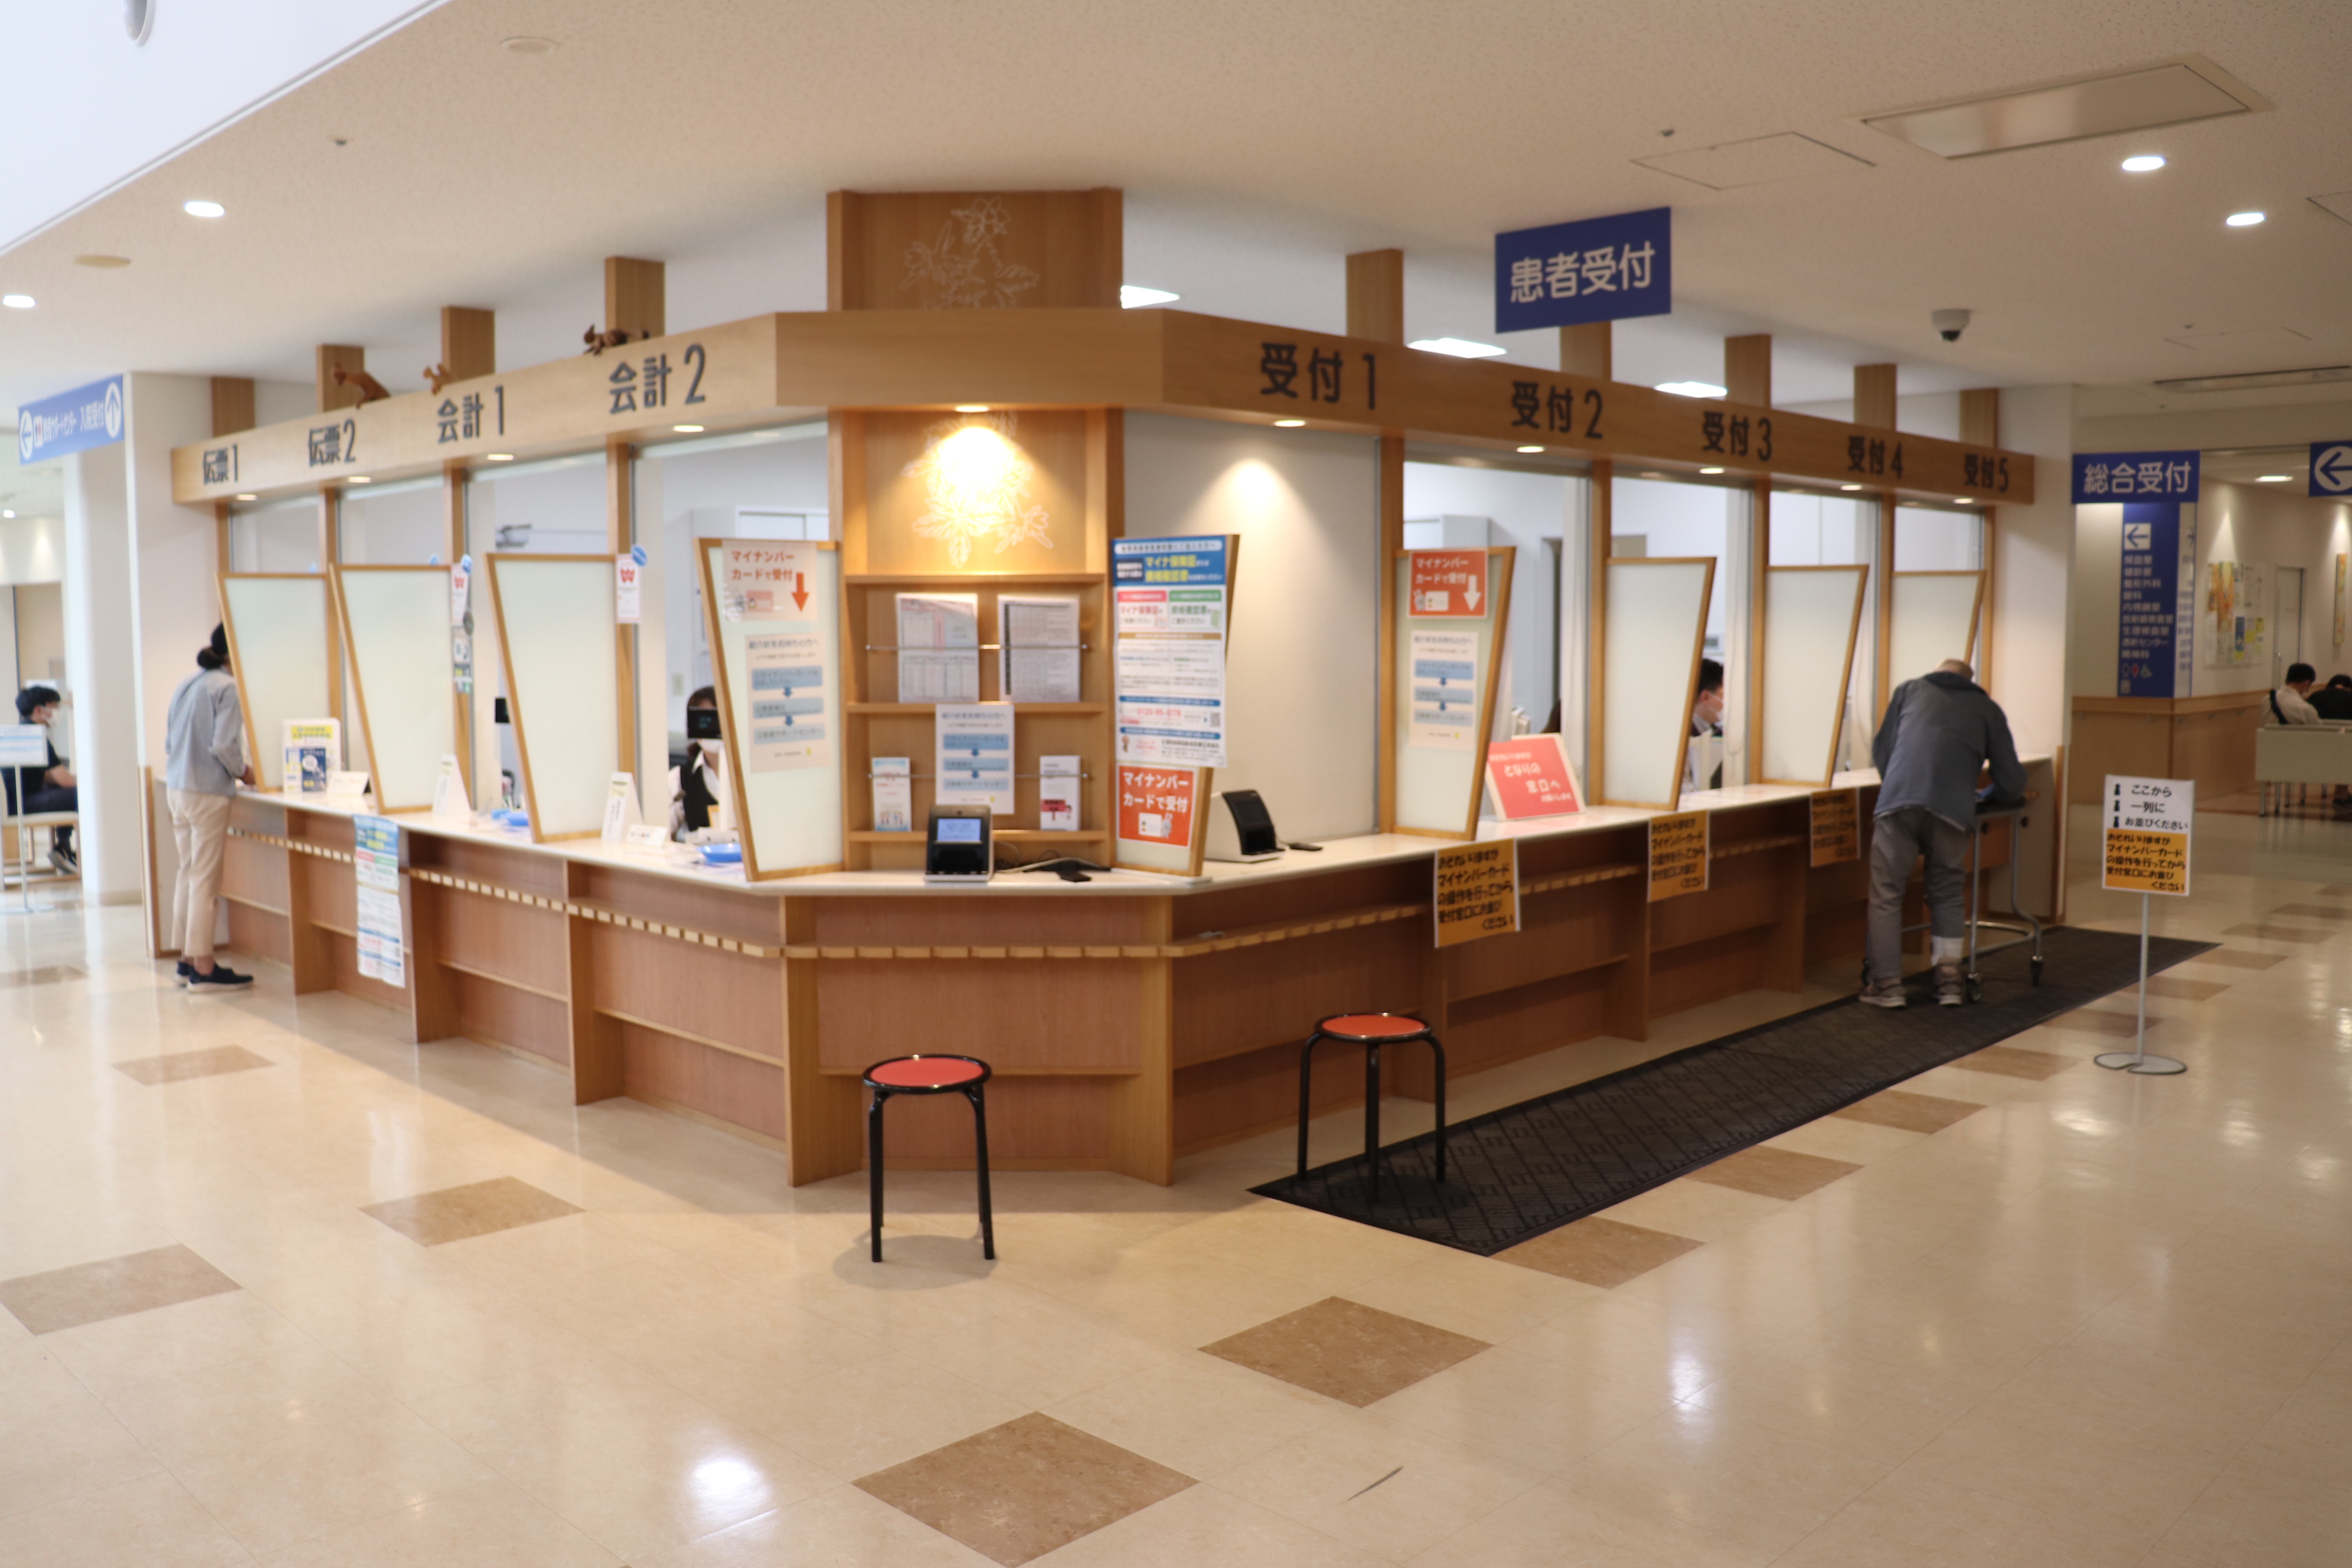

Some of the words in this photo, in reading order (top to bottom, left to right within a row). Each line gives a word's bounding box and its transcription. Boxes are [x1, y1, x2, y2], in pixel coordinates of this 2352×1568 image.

[1510, 241, 1655, 304] 患者受付
[2084, 461, 2191, 494] 総合受付
[731, 550, 796, 563] マイナンバー
[1123, 772, 1189, 789] マイナンバー
[2131, 785, 2172, 797] ここから
[1123, 792, 1188, 813] カードで受付
[2131, 801, 2165, 813] 一列に
[2125, 816, 2188, 830] お並びください
[2107, 844, 2183, 858] マイナンバーカード
[2151, 881, 2185, 891] ください
